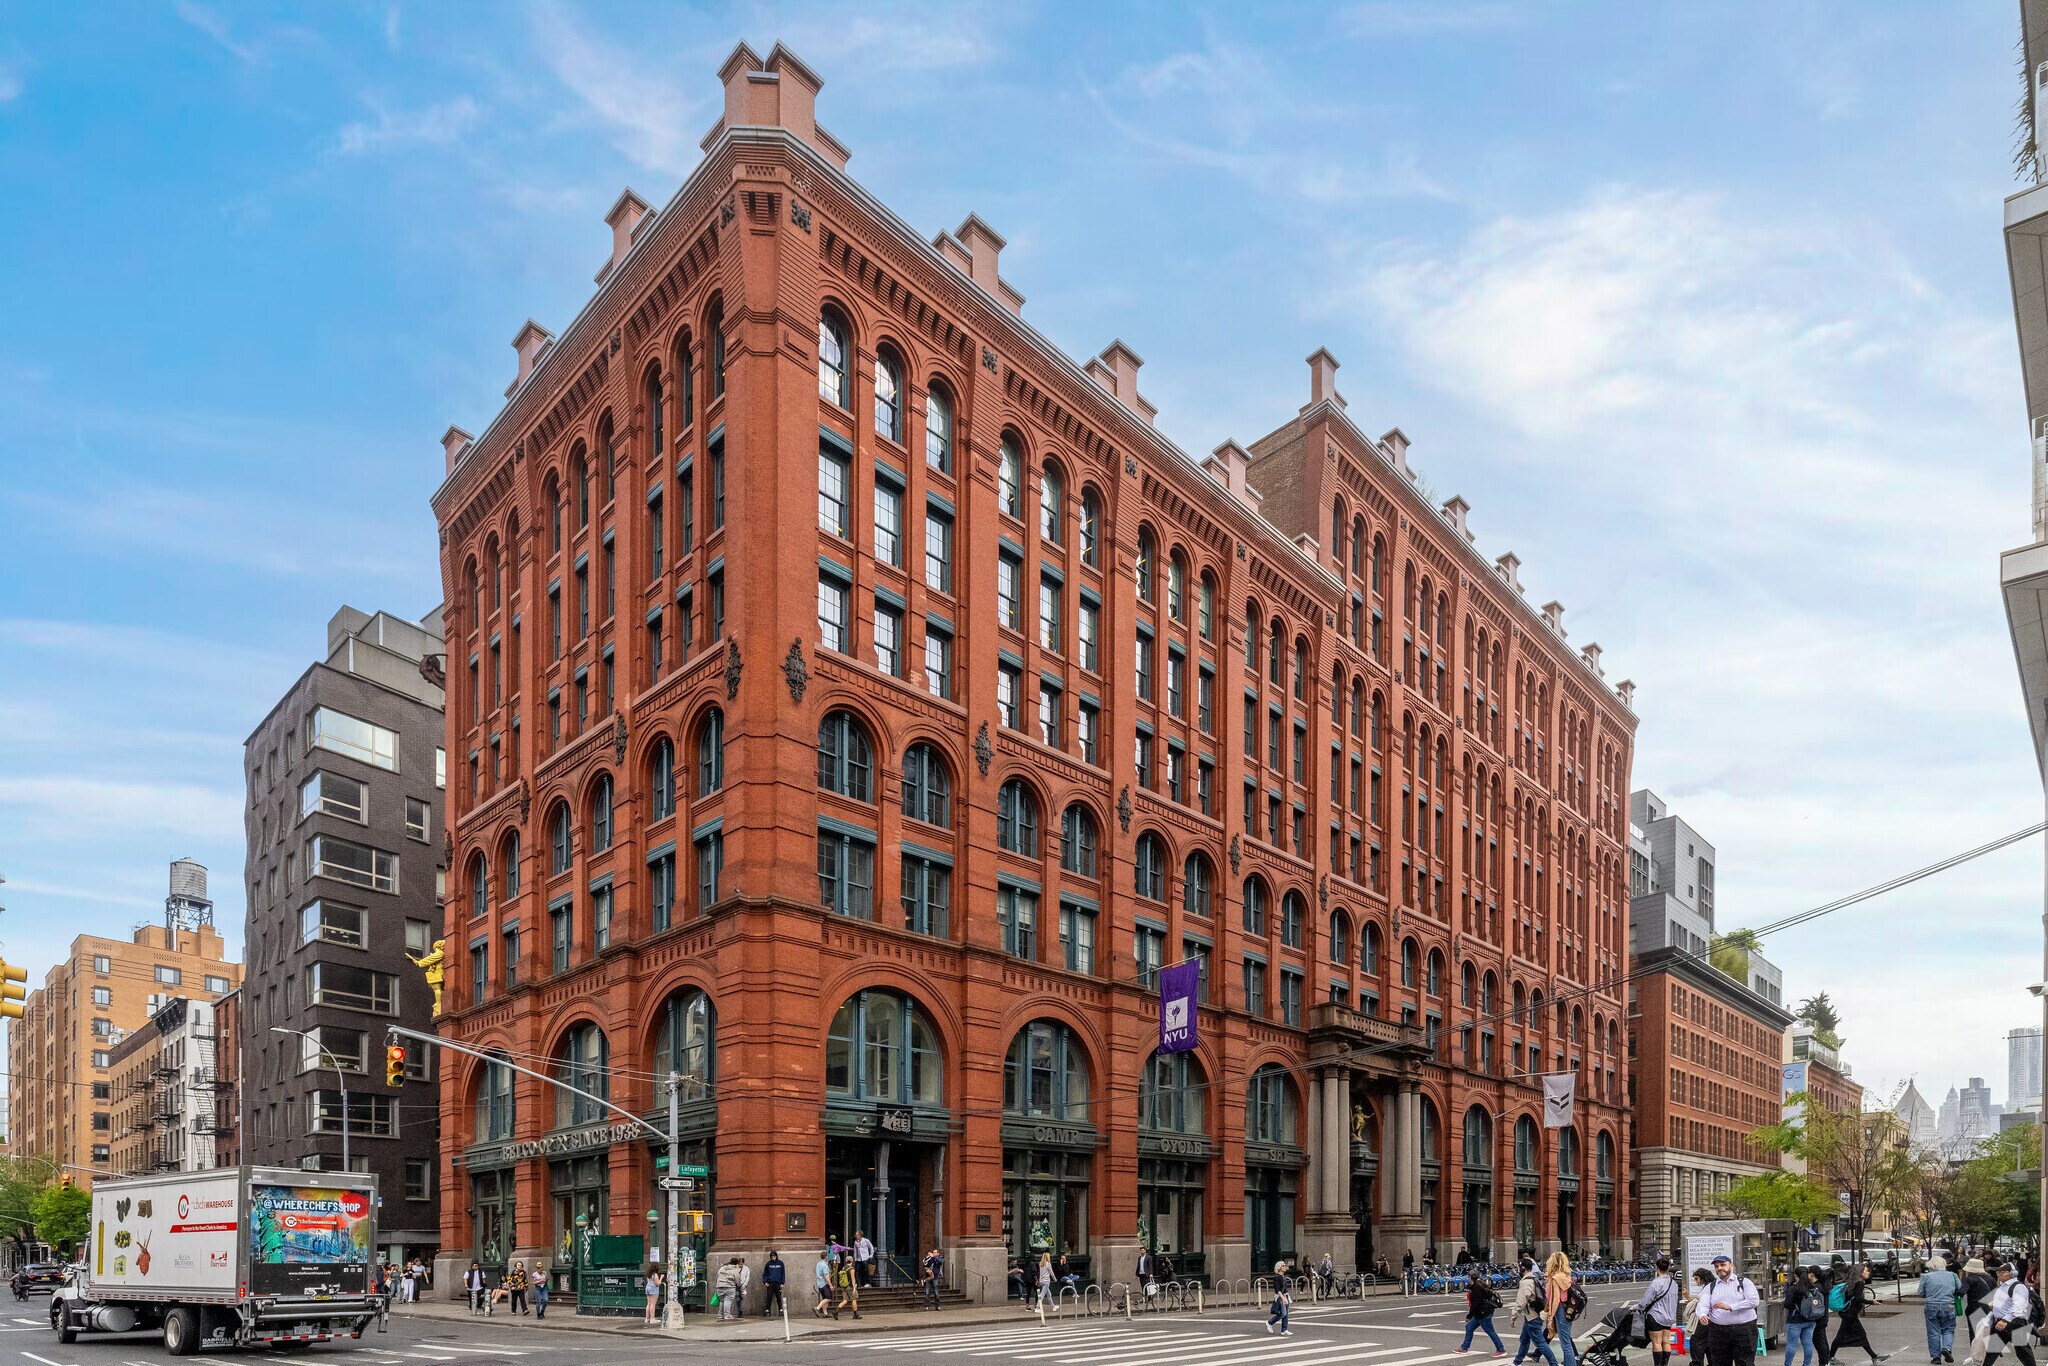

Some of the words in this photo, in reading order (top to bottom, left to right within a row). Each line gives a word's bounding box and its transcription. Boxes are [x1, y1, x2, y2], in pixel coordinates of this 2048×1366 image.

[1164, 1028, 1188, 1044] NYU
[502, 1143, 521, 1160] REI
[570, 1127, 608, 1149] SINCE
[609, 1121, 640, 1142] 1938
[1033, 1126, 1080, 1144] CAMP
[1160, 1138, 1202, 1155] CYCLE
[1269, 1149, 1288, 1163] SKI
[681, 1166, 705, 1174] Lafayette
[263, 1199, 361, 1212] @WHERECHEFSSHOP
[604, 1276, 619, 1285] Subway
